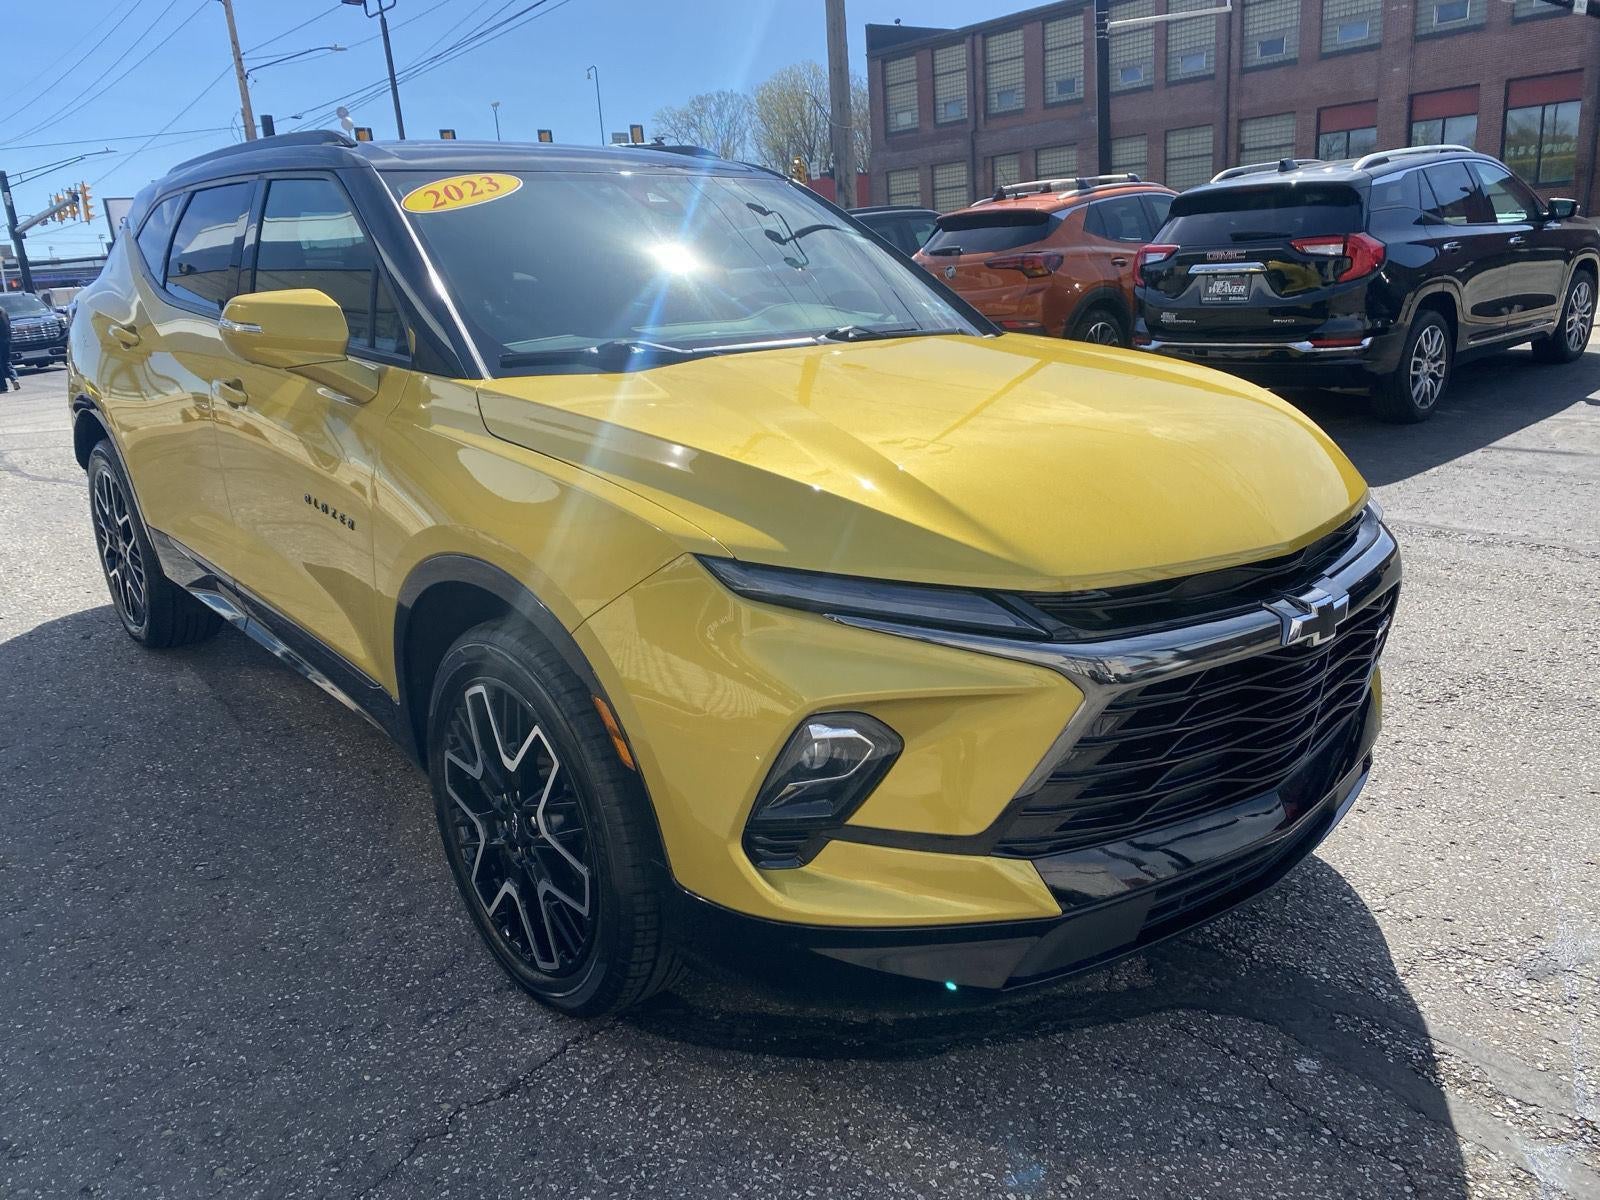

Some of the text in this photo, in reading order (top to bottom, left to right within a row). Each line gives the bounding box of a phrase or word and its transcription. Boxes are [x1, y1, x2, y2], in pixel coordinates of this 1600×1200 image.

[424, 176, 500, 209] 2023
[1206, 250, 1246, 260] GMC
[1208, 285, 1246, 294] WEAVER
[304, 493, 355, 530] BLAZER
